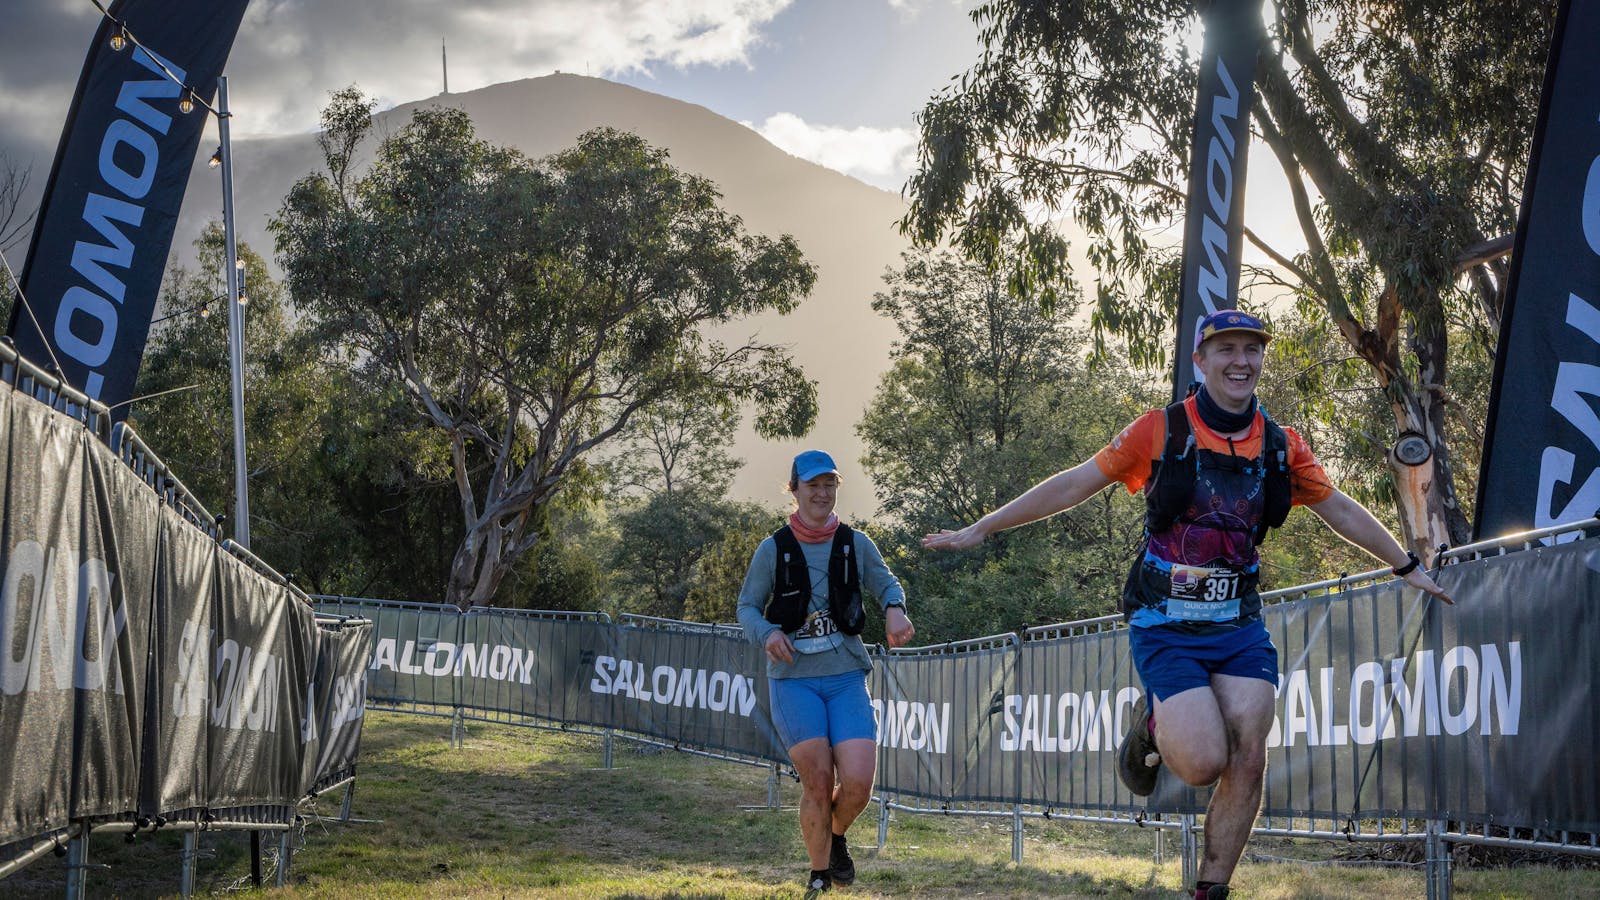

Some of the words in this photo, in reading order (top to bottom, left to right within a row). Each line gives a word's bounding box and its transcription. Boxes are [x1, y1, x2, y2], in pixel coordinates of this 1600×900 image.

[1183, 602, 1208, 610] QUICK
[1204, 578, 1239, 602] 391
[369, 638, 534, 685] ALOMON
[591, 655, 757, 717] SALOMON
